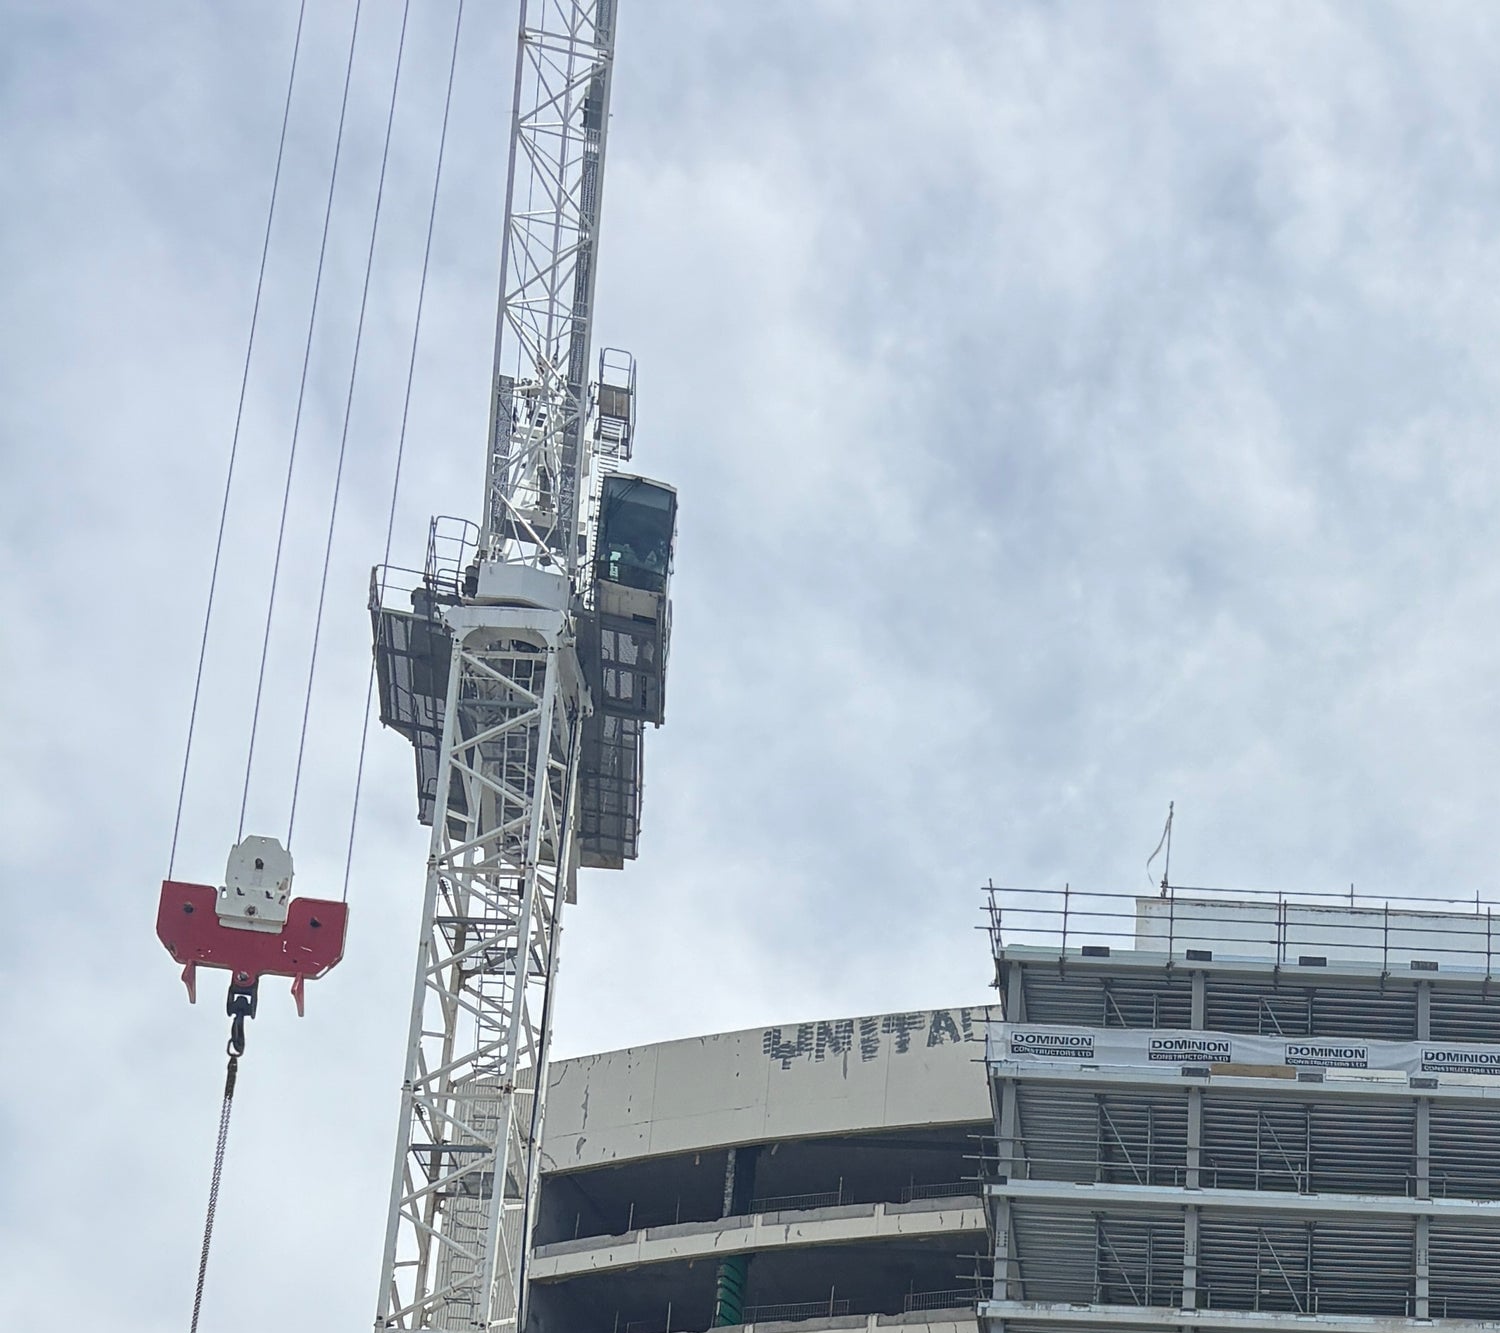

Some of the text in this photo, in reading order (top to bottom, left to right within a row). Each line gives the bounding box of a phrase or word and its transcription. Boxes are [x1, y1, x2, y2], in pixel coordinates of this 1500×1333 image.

[1013, 1034, 1092, 1047] DOMINION
[1151, 1040, 1229, 1053] DOMINION
[1077, 1050, 1093, 1058] LTD
[1288, 1046, 1366, 1059] DOMINION
[1423, 1051, 1500, 1064] DOMINION
[1214, 1055, 1229, 1063] LTD
[1350, 1061, 1366, 1069] LTD
[1485, 1067, 1500, 1075] LTD
